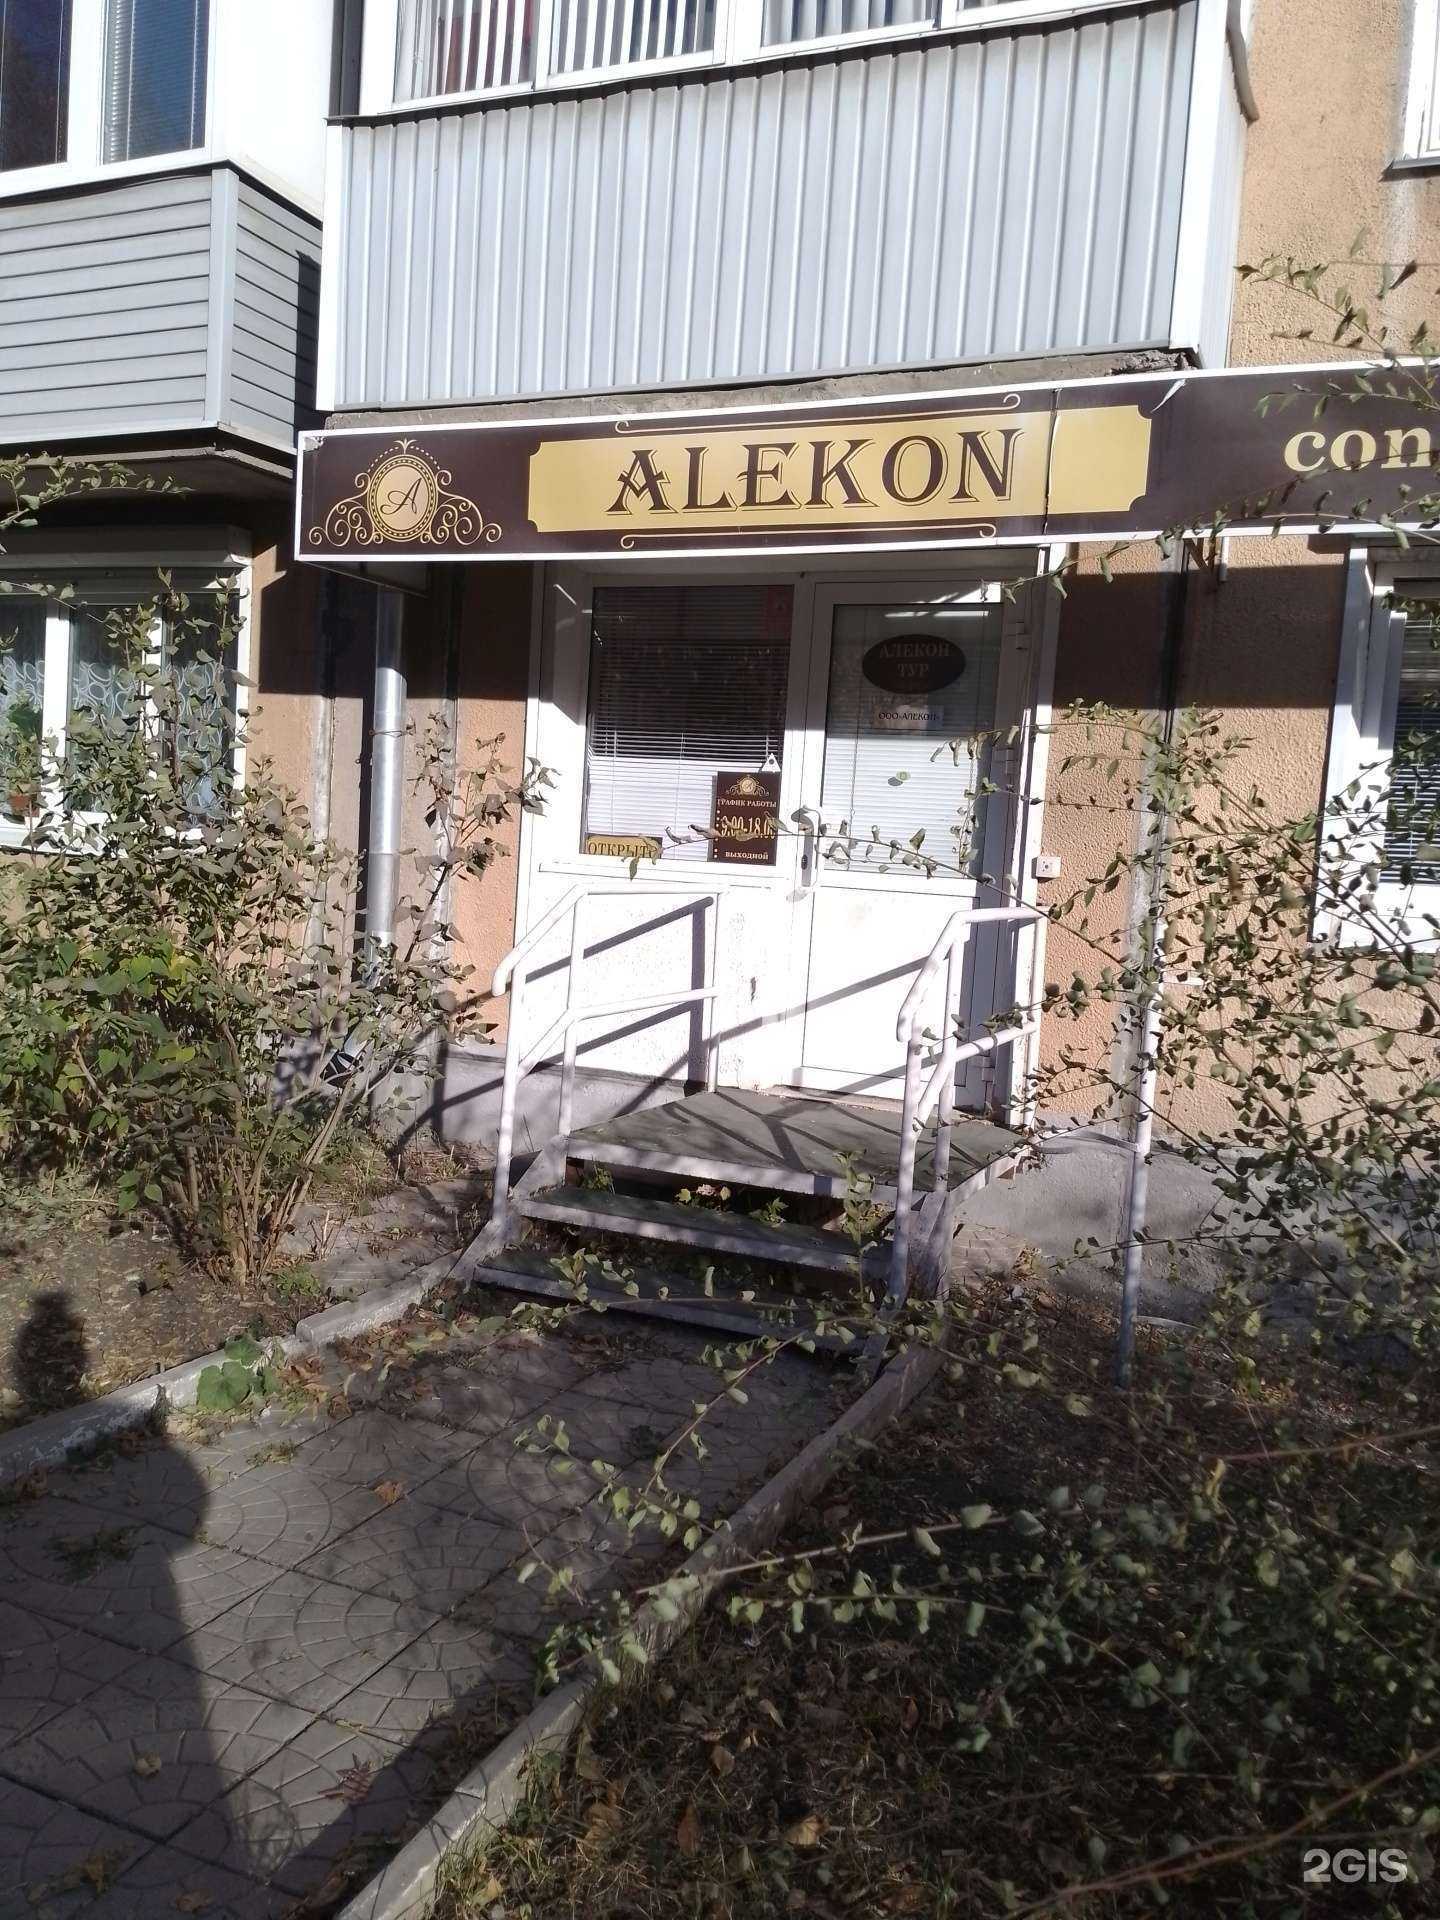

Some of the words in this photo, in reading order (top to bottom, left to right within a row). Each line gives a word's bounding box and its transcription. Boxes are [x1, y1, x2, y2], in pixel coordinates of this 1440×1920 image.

[605, 427, 1024, 516] ALEKON
[880, 642, 950, 658] АЛЕКОН
[897, 663, 930, 678] ТУР
[717, 798, 746, 806] ГРАФИК
[747, 800, 777, 808] РАБОТЫ
[725, 851, 769, 860] ВЫХОДНОЙ
